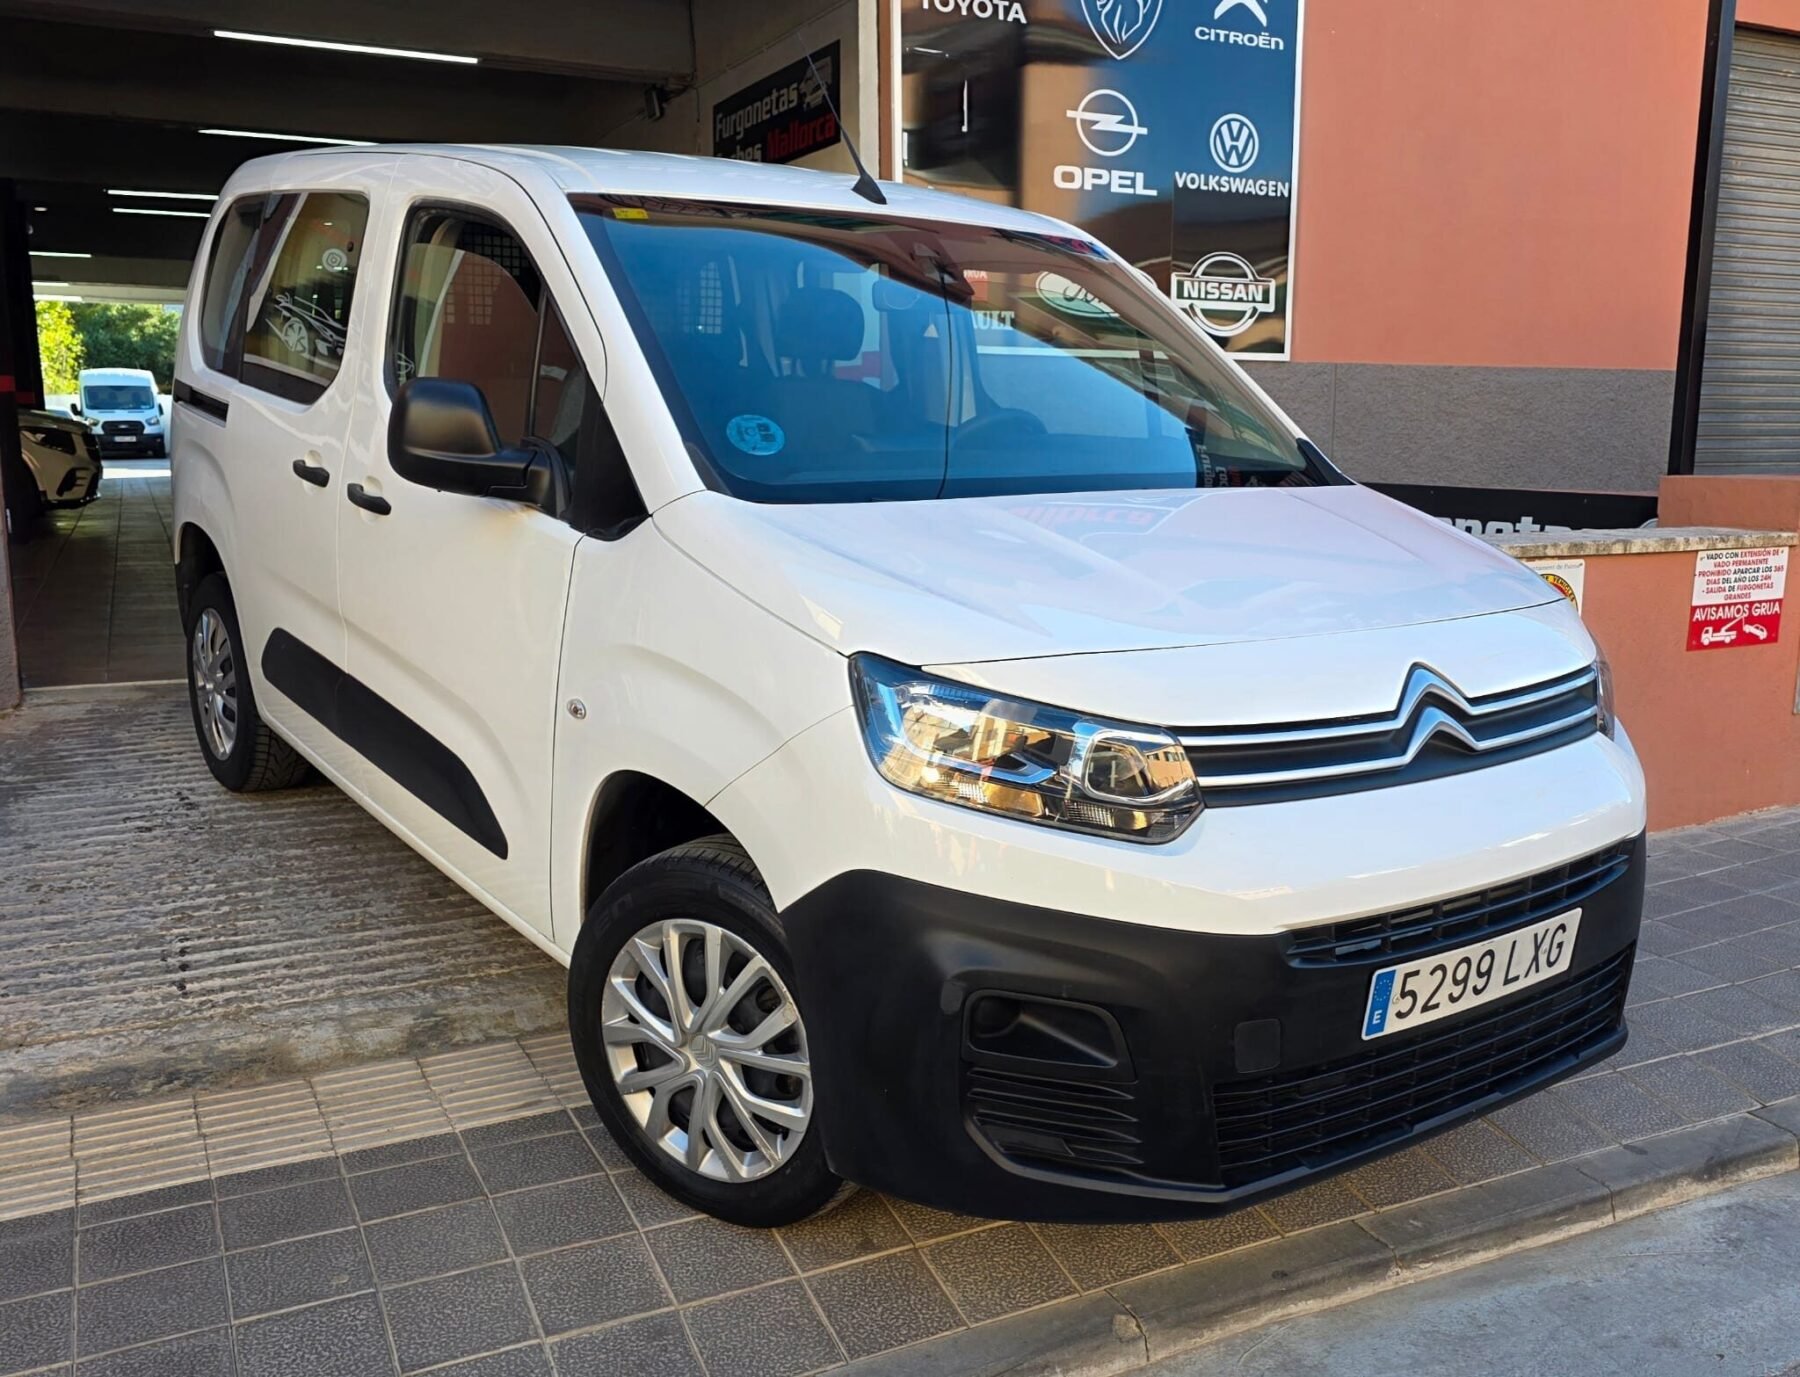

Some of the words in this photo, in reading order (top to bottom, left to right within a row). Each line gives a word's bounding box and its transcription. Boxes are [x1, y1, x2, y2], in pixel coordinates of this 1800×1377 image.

[716, 82, 798, 142] Furgonetas
[1053, 165, 1158, 196] OPEL
[1175, 171, 1290, 198] VOLKSWAGEN
[1183, 280, 1263, 302] NISSAN
[1706, 552, 1723, 560] VADO
[1724, 551, 1739, 559] CON
[1731, 558, 1769, 567] PERMANENTE
[1698, 569, 1732, 578] PROHIBIDO
[1732, 567, 1760, 575] APARCAR
[1705, 586, 1726, 594] SALIDA
[1736, 582, 1774, 591] FURGONETAS
[1723, 592, 1751, 601] GRANDES
[1693, 604, 1750, 621] AVISAMOS
[1752, 601, 1781, 616] GRUA
[1394, 949, 1495, 1019] 5299
[1503, 922, 1566, 986] LXG
[1372, 1010, 1382, 1024] E
